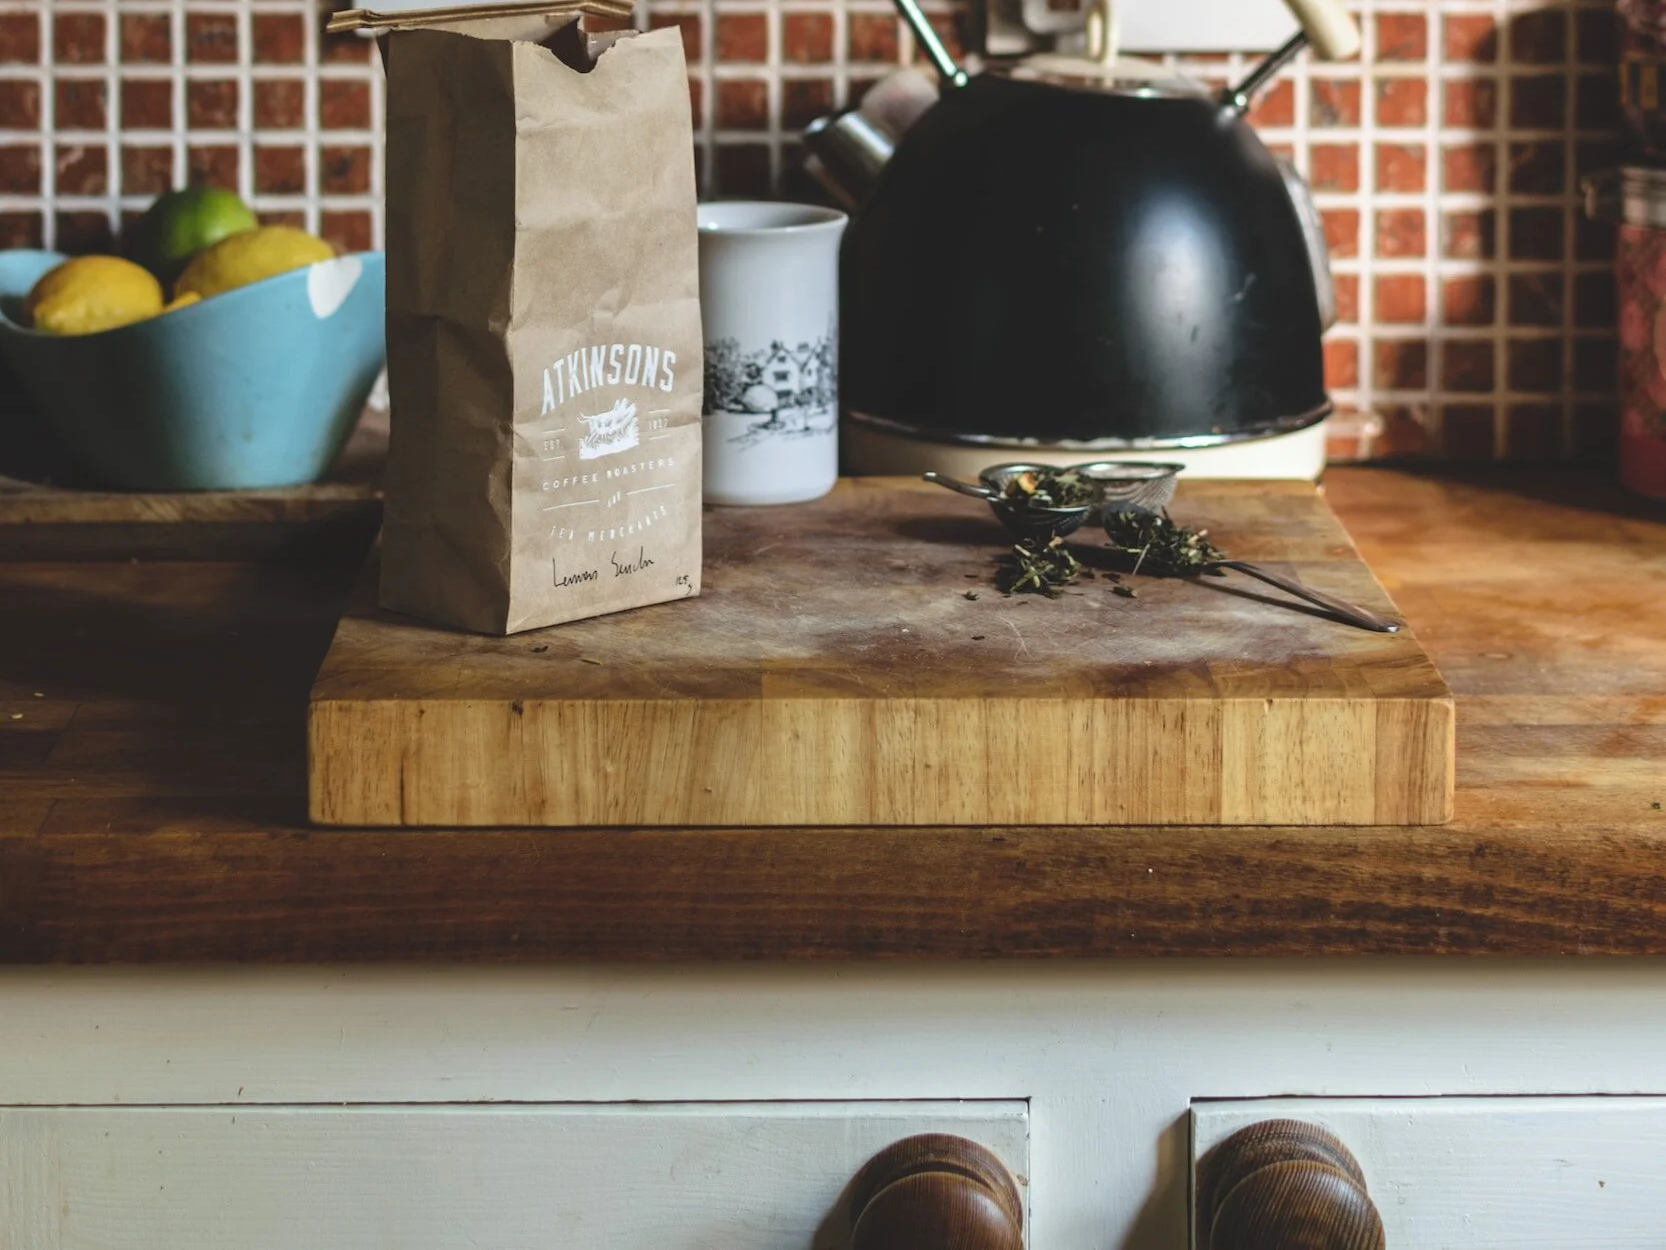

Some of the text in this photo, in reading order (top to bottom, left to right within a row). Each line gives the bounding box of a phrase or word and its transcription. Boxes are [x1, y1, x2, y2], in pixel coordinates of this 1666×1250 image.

[541, 344, 677, 415] ATKINSONS
[542, 457, 675, 491] COFFEE ROASTERS
